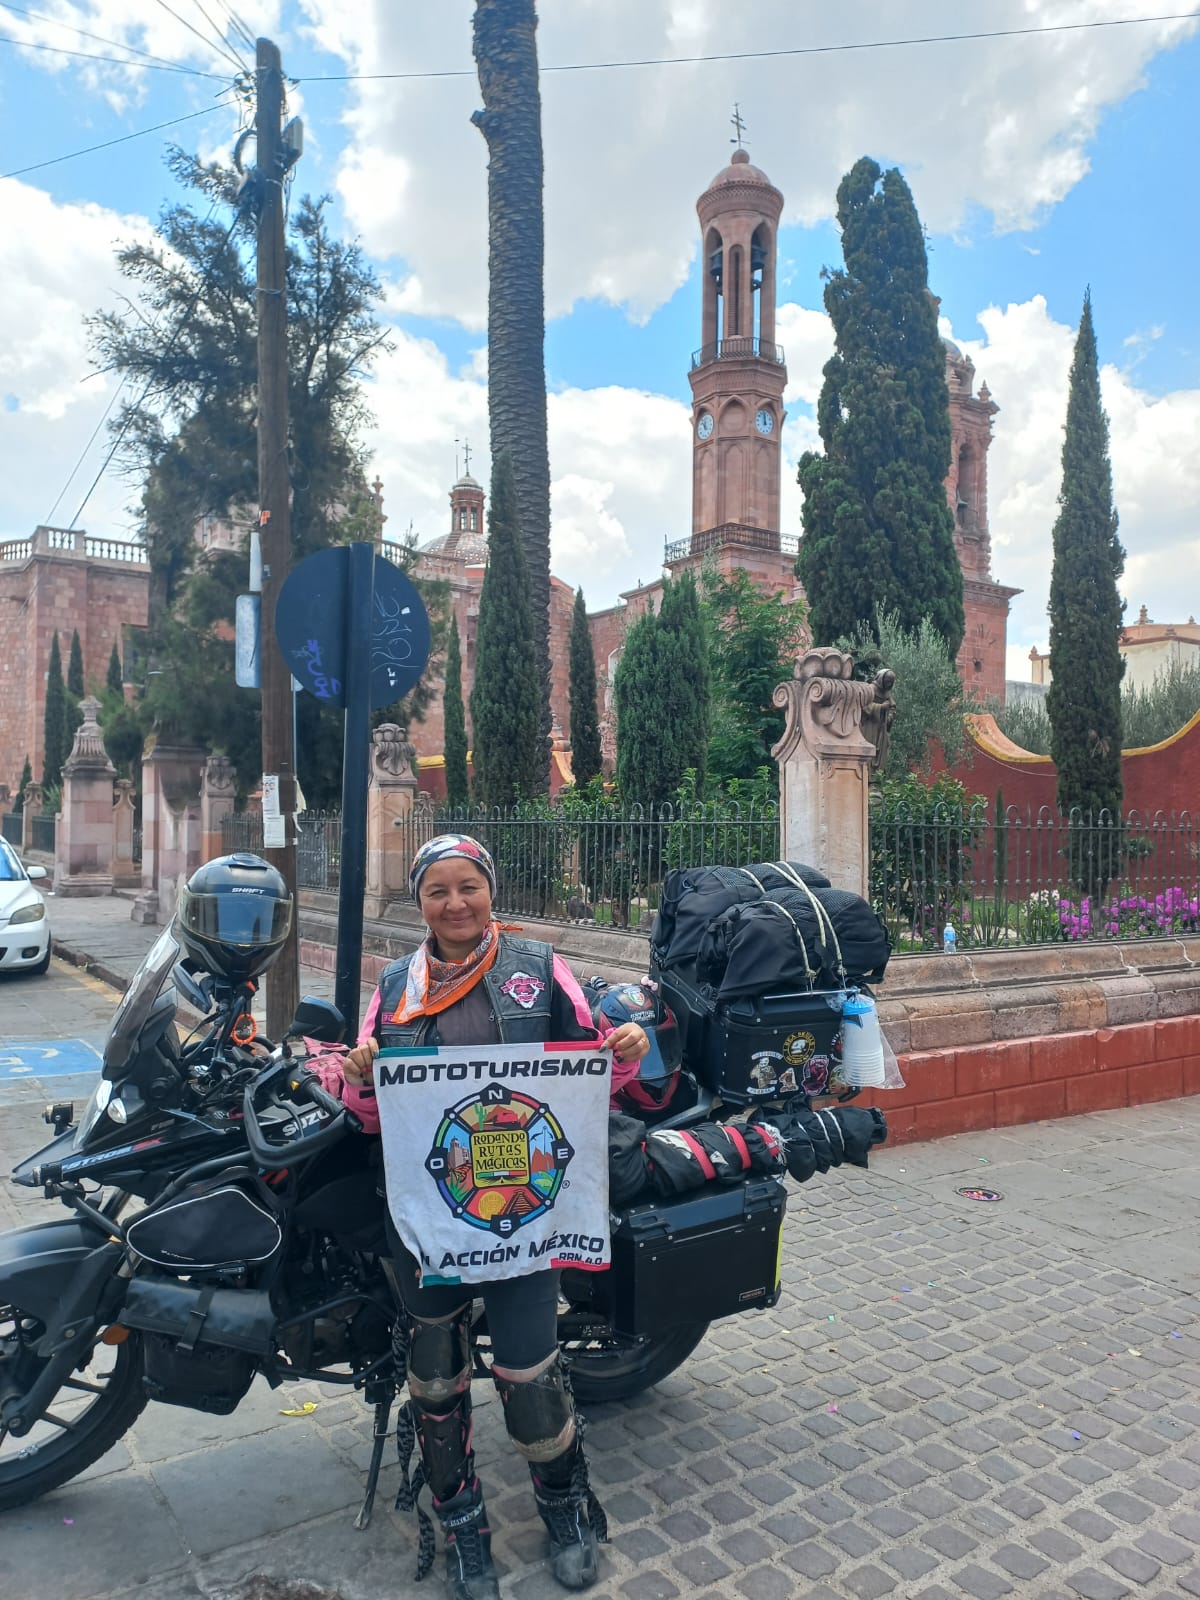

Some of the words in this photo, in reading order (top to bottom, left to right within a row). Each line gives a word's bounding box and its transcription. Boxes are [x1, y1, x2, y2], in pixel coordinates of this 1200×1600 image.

[380, 1058, 607, 1087] MOTOTURISMO
[488, 1090, 503, 1100] N
[282, 1110, 330, 1137] SUZU
[557, 1148, 569, 1159] E
[430, 1158, 444, 1169] O
[500, 1220, 512, 1232] S
[439, 1242, 521, 1269] ACCIÓN
[528, 1230, 605, 1258] MÉXICO
